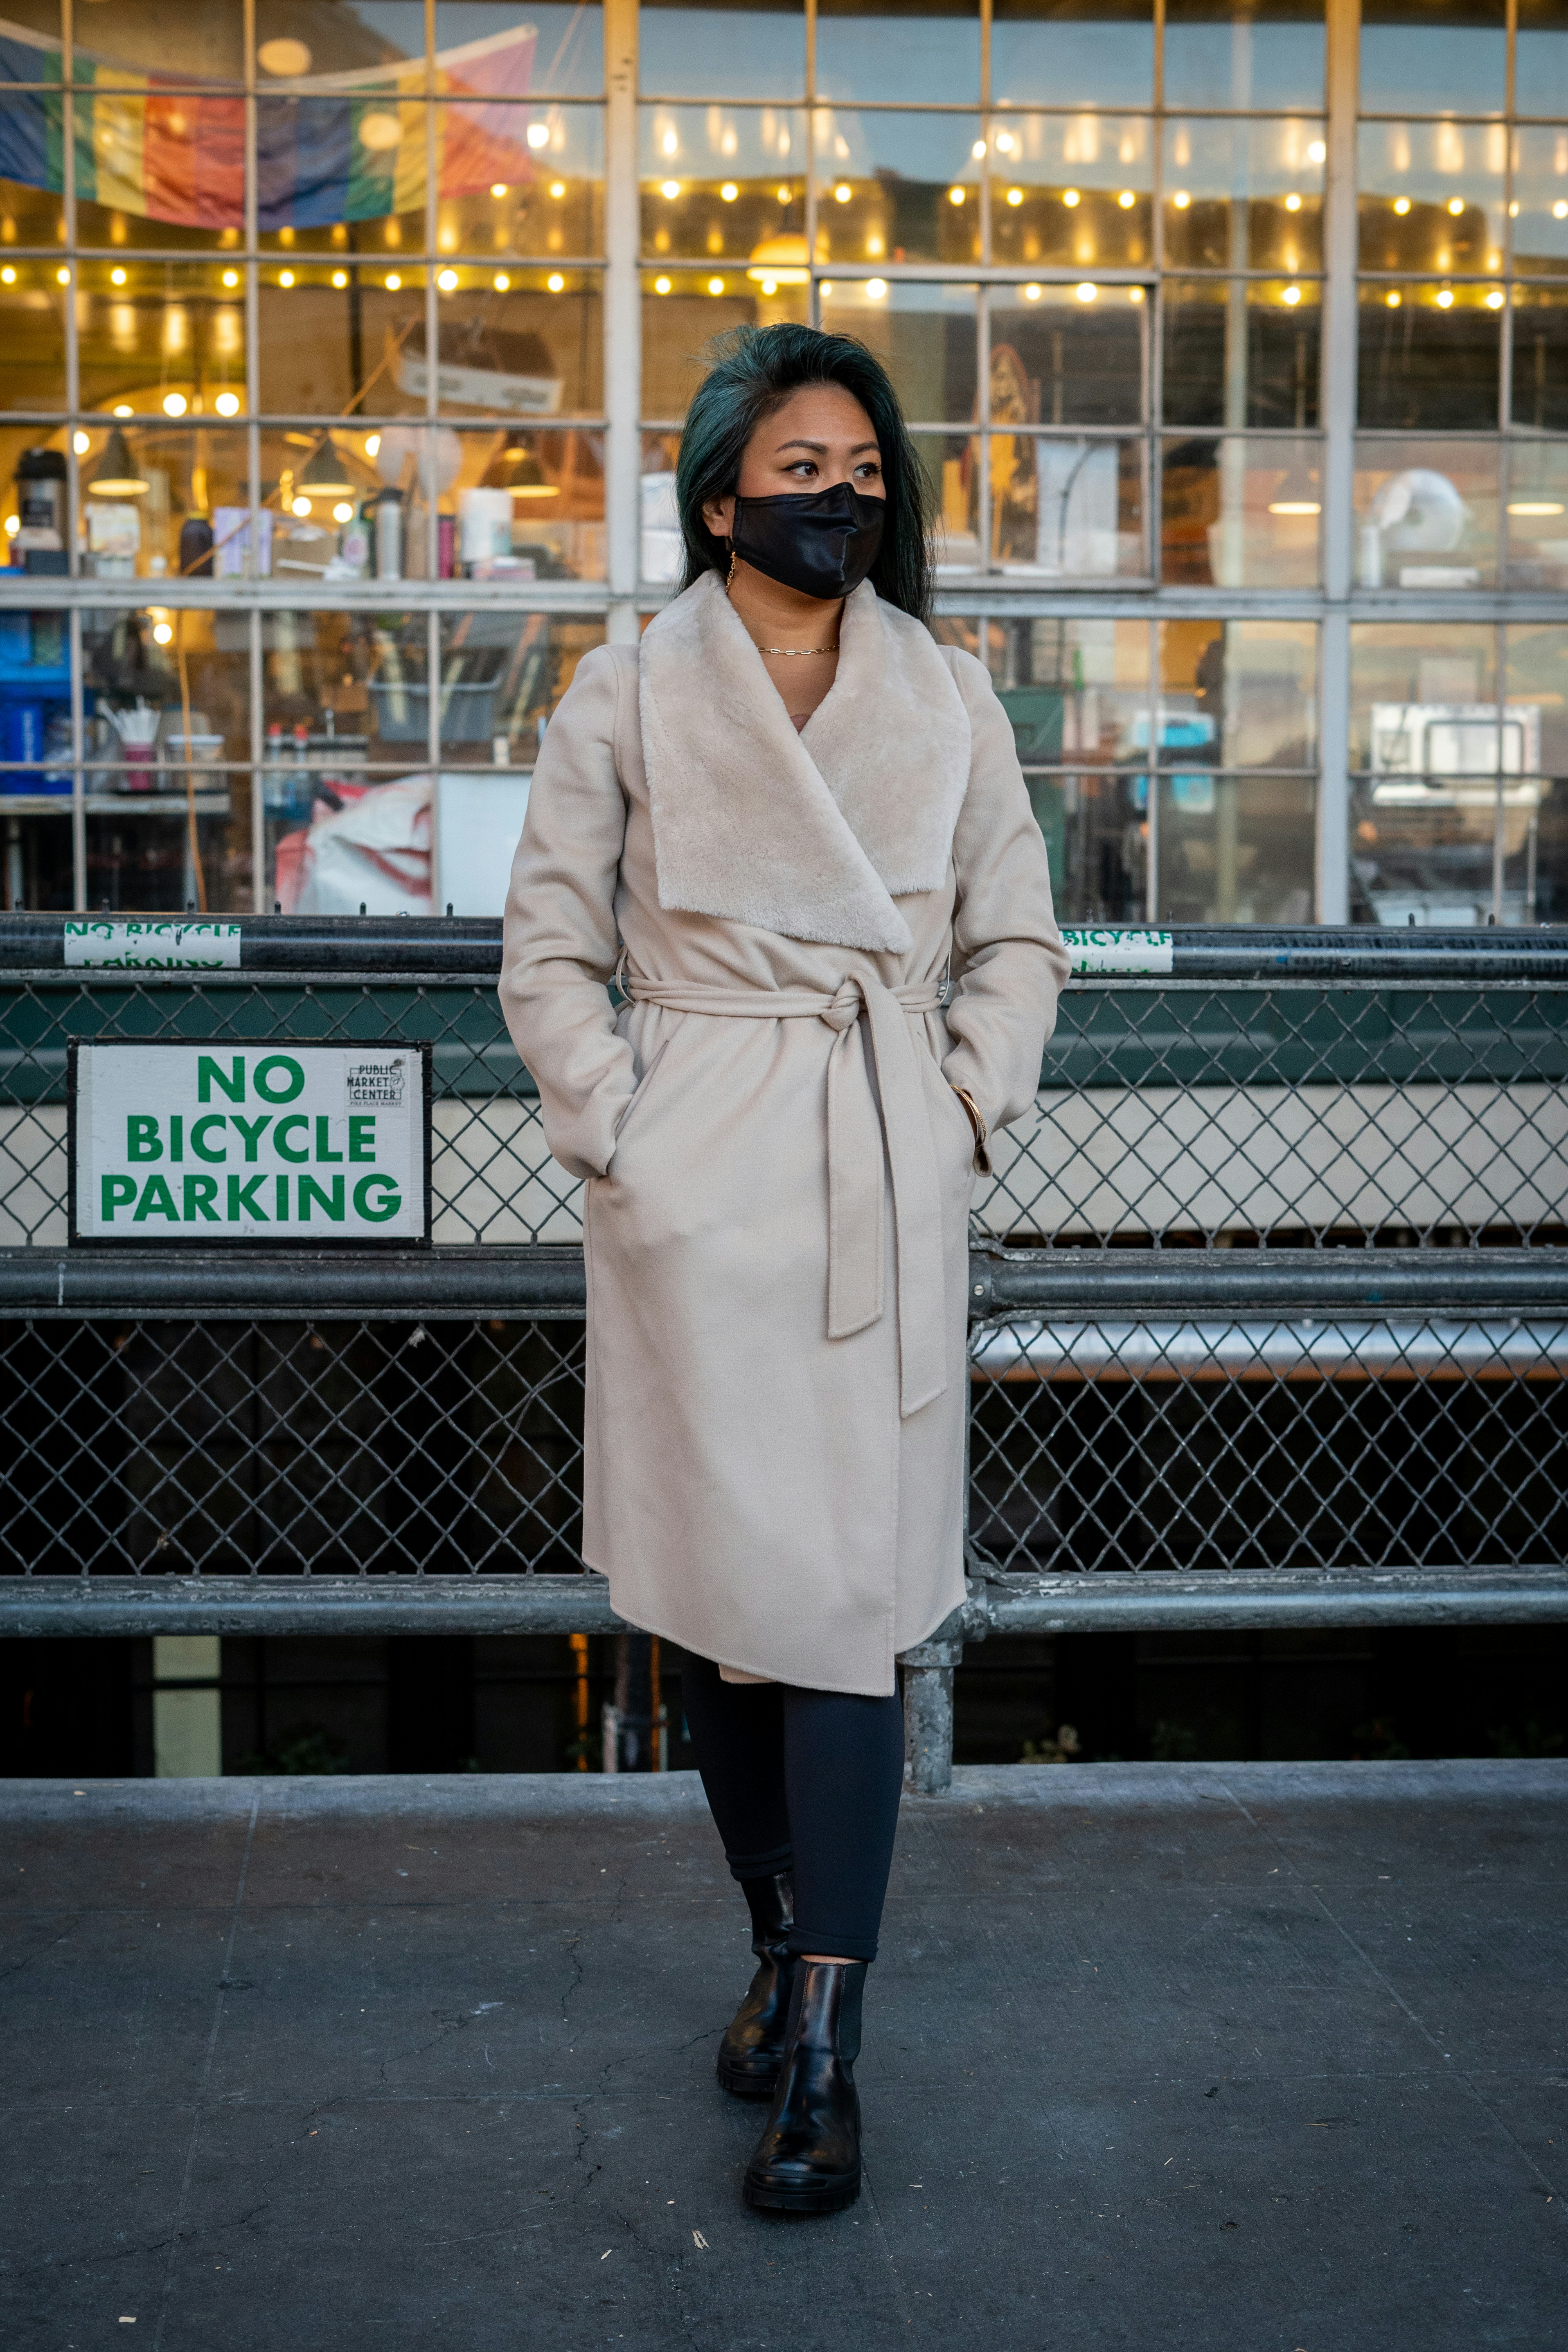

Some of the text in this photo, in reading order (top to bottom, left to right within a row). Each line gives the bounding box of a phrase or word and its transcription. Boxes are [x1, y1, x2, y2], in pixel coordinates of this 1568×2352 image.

[198, 1055, 305, 1104] NO
[347, 1077, 389, 1087] MARKET
[360, 1065, 396, 1075] PUBLIC
[354, 1089, 395, 1099] CENTER
[127, 1114, 376, 1163] BICYCLE
[101, 1174, 402, 1222] PARKING
